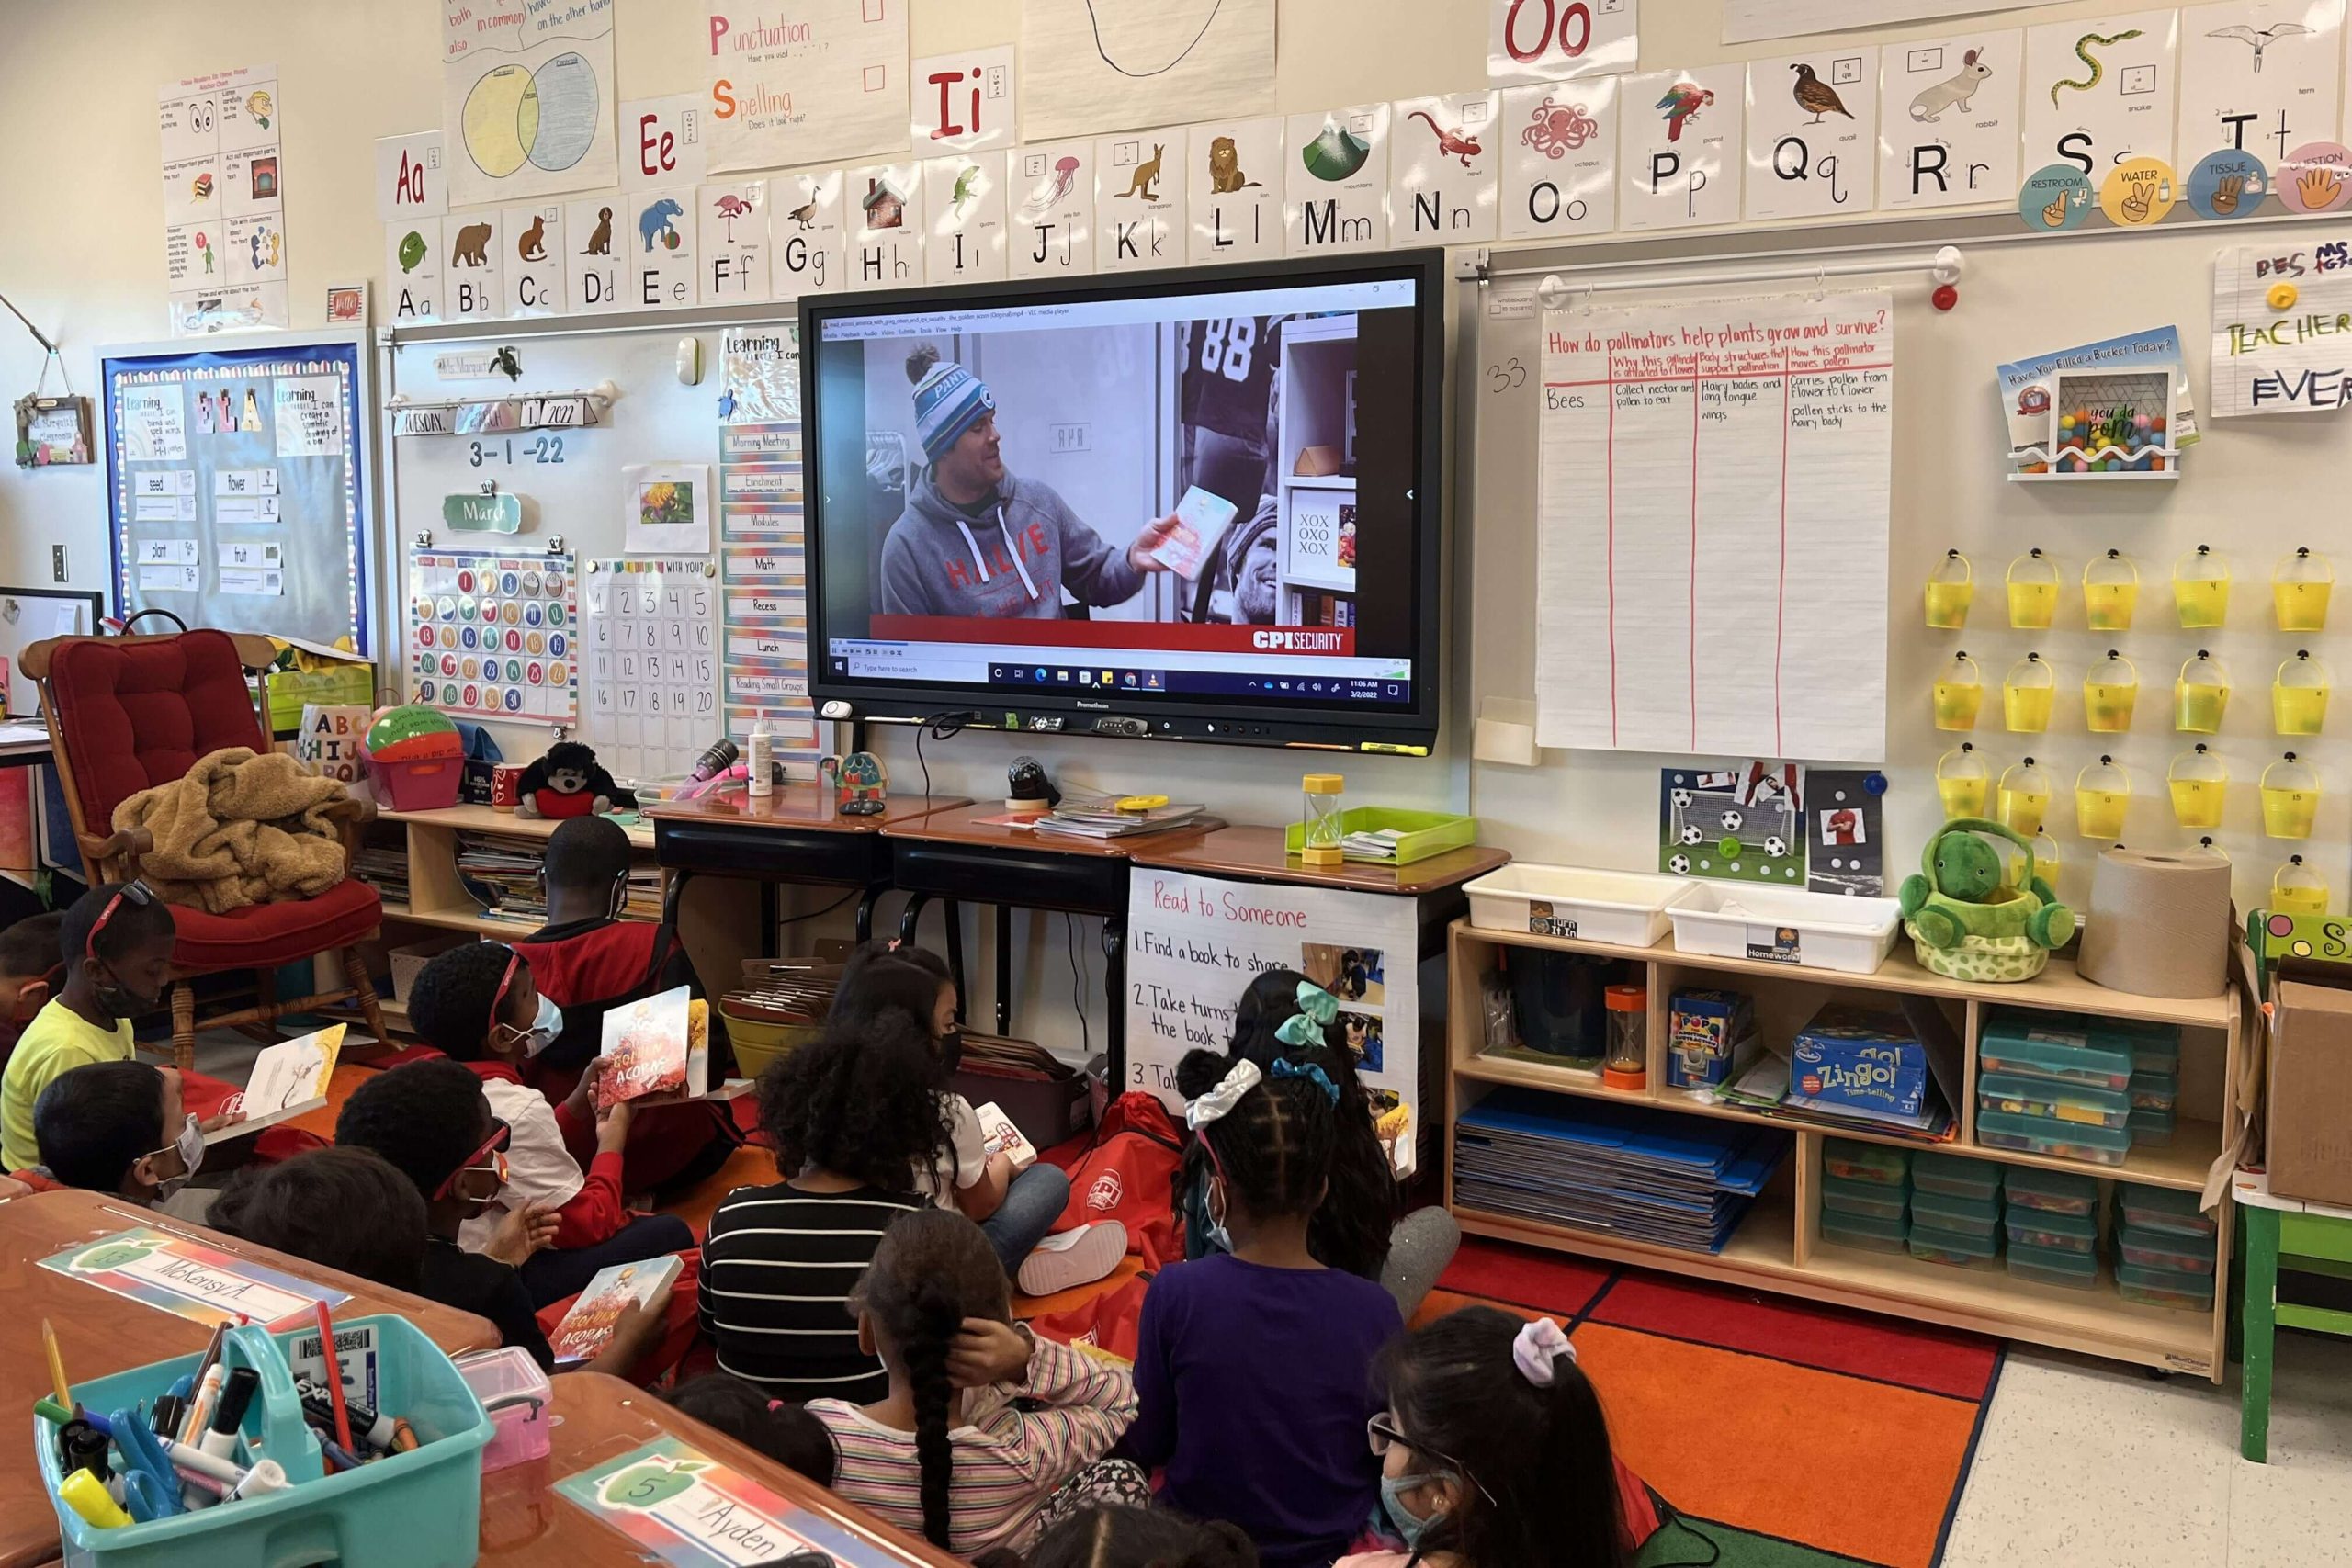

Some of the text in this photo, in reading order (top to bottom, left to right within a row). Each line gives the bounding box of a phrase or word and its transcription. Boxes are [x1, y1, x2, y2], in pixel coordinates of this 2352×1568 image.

[449, 7, 472, 27] both
[477, 12, 525, 32] in common
[537, 19, 548, 30] on
[550, 11, 563, 26] the
[565, 6, 587, 21] other
[449, 39, 468, 54] also
[747, 53, 762, 63] Have
[713, 79, 792, 120] Spelling
[2127, 103, 2153, 113] snake
[749, 119, 765, 130] Does
[1975, 119, 1998, 129] rabbit
[1702, 135, 1724, 145] parrot
[1839, 134, 1857, 142] quail
[1574, 160, 1600, 168] octopus
[2209, 161, 2247, 175] TISSUE
[2031, 177, 2084, 189] RESTROOM
[2120, 169, 2158, 183] WATER
[1343, 182, 1373, 190] mountains
[1148, 202, 1172, 210] kangaroo
[2256, 253, 2306, 278] BES
[1549, 310, 1885, 356] How do pollinators help plants grow and survive?
[2227, 313, 2351, 355] TEACHER
[727, 335, 780, 355] Learning
[1792, 342, 1875, 360] How this pollinator
[1614, 354, 1663, 367] Why this
[1701, 348, 1786, 364] Body structures that
[1792, 355, 1849, 368] moves pollen
[2008, 371, 2034, 386] Have
[2035, 362, 2055, 376] You
[2056, 353, 2083, 371] Filled
[2093, 345, 2129, 362] Bucket
[2132, 339, 2173, 355] Today?
[1614, 369, 1621, 378] is
[1660, 366, 1668, 376] to
[1701, 361, 1780, 376] support pollination
[1702, 378, 1781, 393] Hairy bodies and
[1790, 370, 1888, 389] Carries pollen from
[1615, 381, 1695, 396] Collect nectar and
[1791, 383, 1875, 399] flower to flower
[1547, 387, 1585, 411] Bees
[1616, 394, 1671, 410] pollen to eat
[1701, 391, 1758, 407] long tongue
[549, 405, 575, 424] 2022
[1701, 410, 1728, 423] wings
[1792, 402, 1887, 419] pollen sticks to the
[2090, 405, 2135, 420] you da
[1791, 414, 1843, 430] hairy body
[2086, 420, 2139, 446] pom
[733, 434, 791, 450] Morning Meeting
[149, 478, 164, 491] seed
[228, 472, 245, 491] flower
[745, 473, 783, 487] Enrichment
[463, 501, 506, 522] March
[751, 514, 779, 527] Modules
[1299, 514, 1329, 528] XOX
[1299, 527, 1329, 542] OXO
[152, 543, 167, 559] plant
[234, 547, 247, 563] fruit
[1298, 540, 1329, 555] XOX
[666, 561, 704, 574] WITH YOU?
[755, 558, 776, 570] Math
[695, 592, 706, 615] 5
[753, 599, 777, 612] Recess
[696, 626, 709, 646] 10
[757, 640, 779, 652] Lunch
[864, 663, 877, 673] Type
[878, 664, 890, 672] here
[899, 665, 917, 673] search
[736, 678, 804, 692] Reading Small Groups
[1350, 680, 1364, 688] 11:06
[697, 691, 712, 712] 20
[1350, 690, 1378, 699] 3/2/2022
[1153, 879, 1307, 928] Read to Someone
[1552, 917, 1575, 928] Turn
[1551, 927, 1577, 938] It In
[1179, 948, 1185, 960] a
[1188, 940, 1221, 967] book
[1225, 946, 1240, 969] to
[1149, 985, 1229, 1021] Take turns
[1151, 1013, 1216, 1046] the book
[1816, 1062, 1897, 1089] Zingo!
[1844, 1088, 1895, 1102] Time-telling
[628, 1478, 667, 1498] 5
[698, 1504, 775, 1559] Ayden
